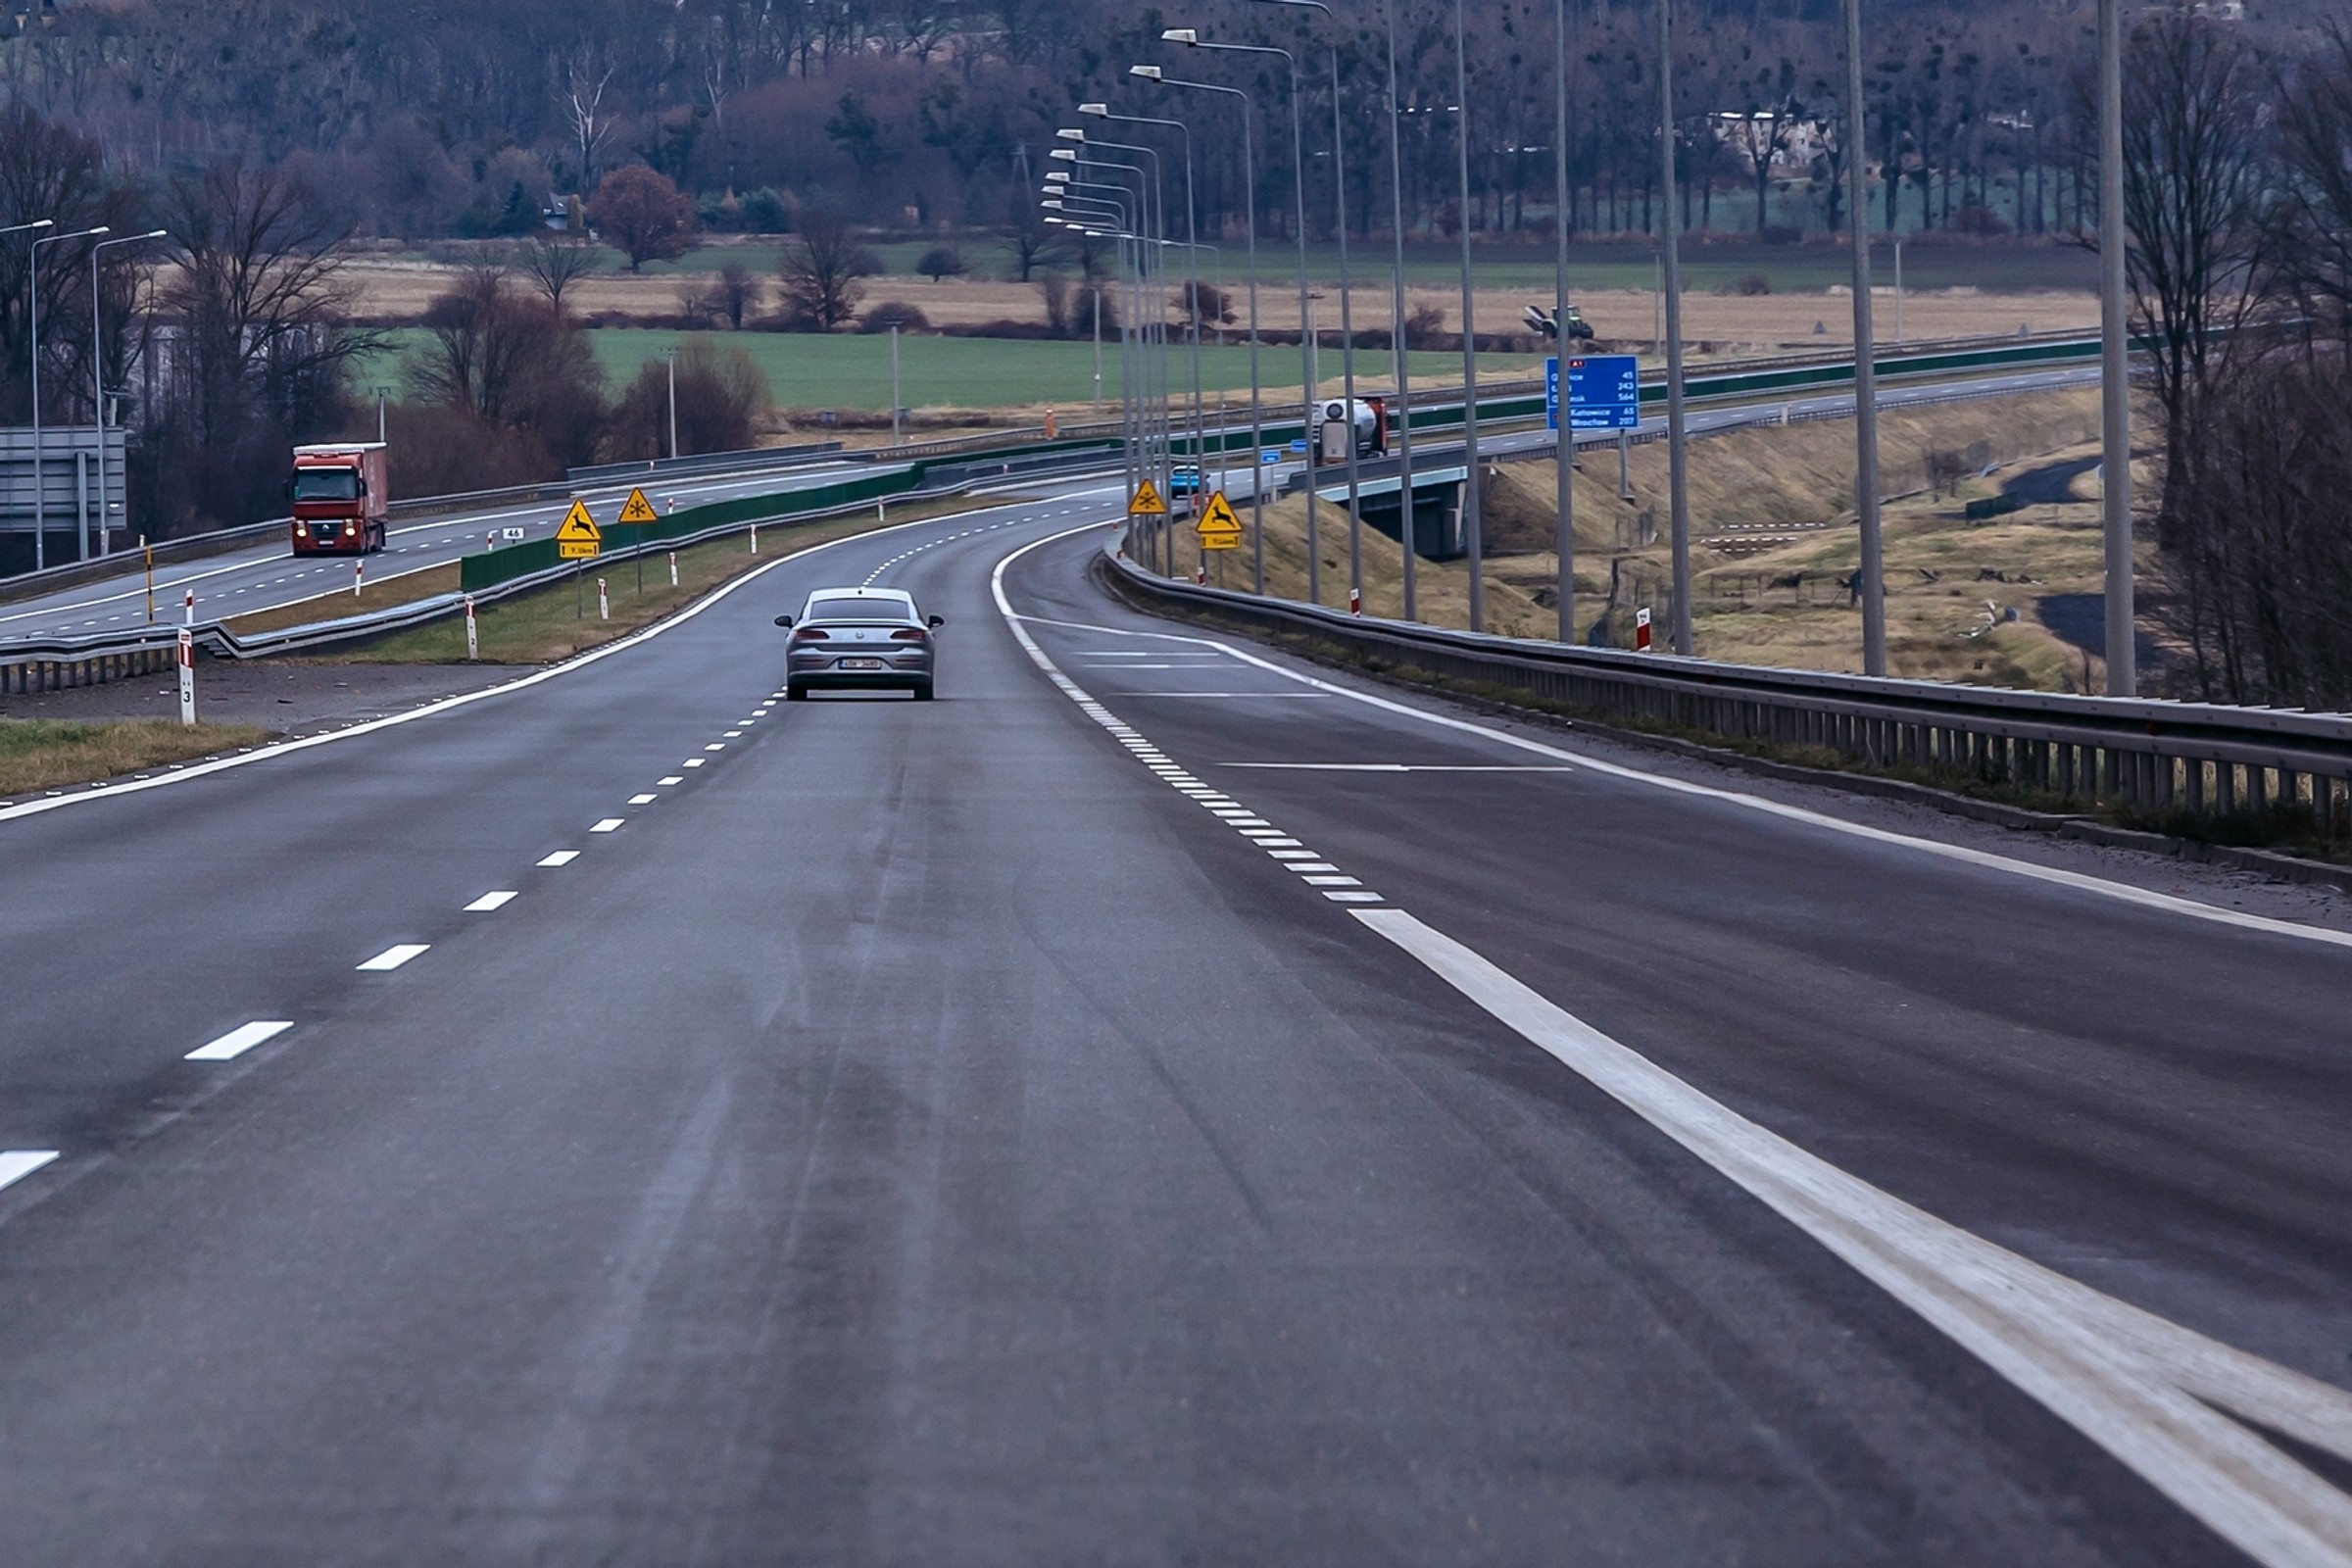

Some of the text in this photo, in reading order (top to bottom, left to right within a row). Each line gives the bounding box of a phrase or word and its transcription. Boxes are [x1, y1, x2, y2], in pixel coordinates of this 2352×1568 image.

[1617, 382, 1634, 391] 243
[1570, 408, 1611, 416] Katowice
[1571, 416, 1635, 426] Wrocław 207
[183, 691, 191, 703] 3
